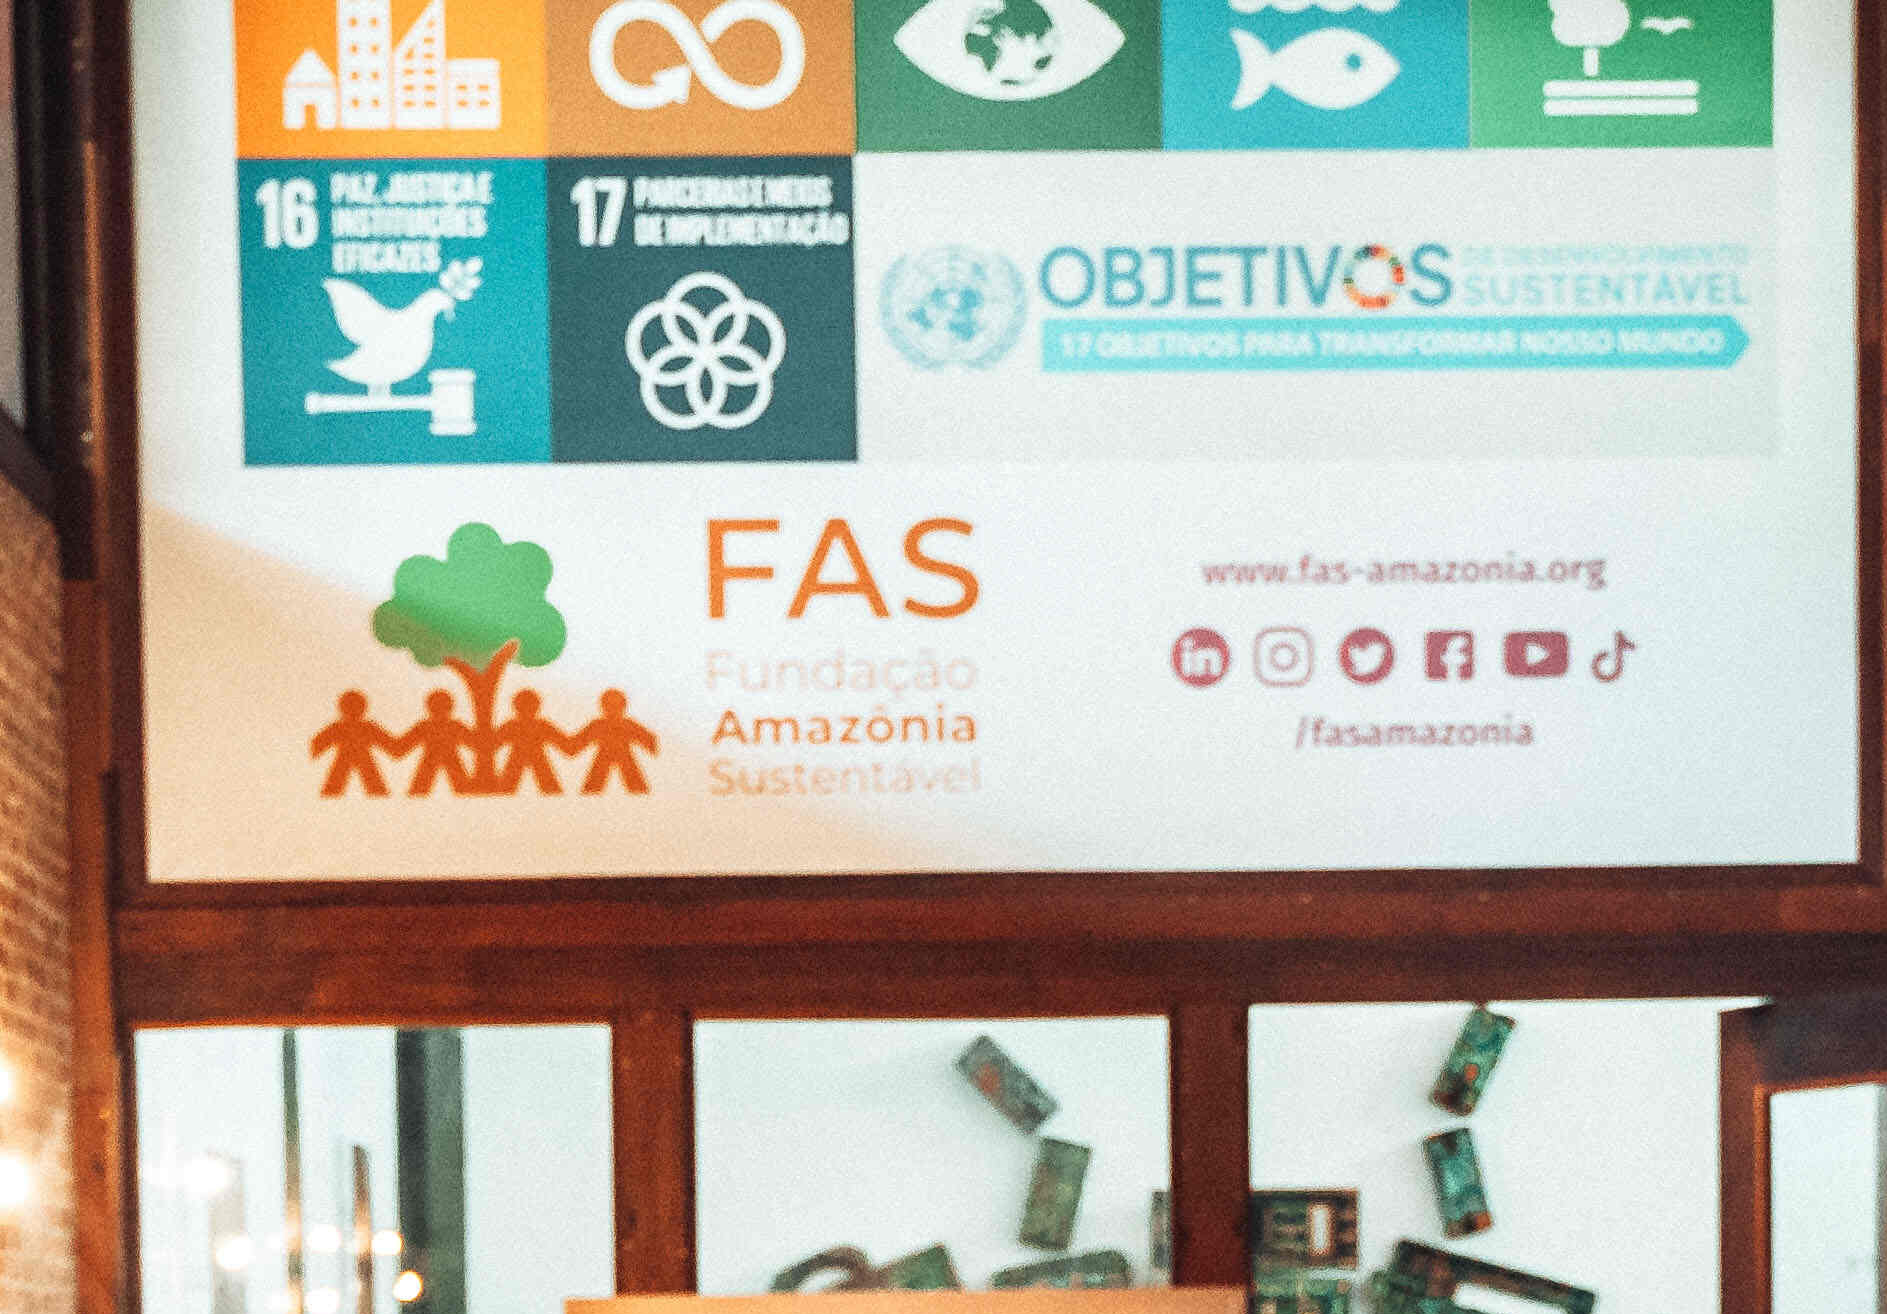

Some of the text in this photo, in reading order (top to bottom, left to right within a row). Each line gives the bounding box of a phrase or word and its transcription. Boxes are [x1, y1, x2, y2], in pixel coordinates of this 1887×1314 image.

[255, 178, 319, 249] 16
[570, 177, 628, 247] 17
[1038, 243, 1455, 311] OBJETIVOS
[1060, 331, 1091, 357] 17
[705, 518, 984, 620] FAS
[1200, 551, 1608, 590] www.fas-amazonia.org
[705, 646, 978, 700] Fundação
[710, 700, 978, 745] Amazônia
[1296, 715, 1535, 750] /fasamazonia
